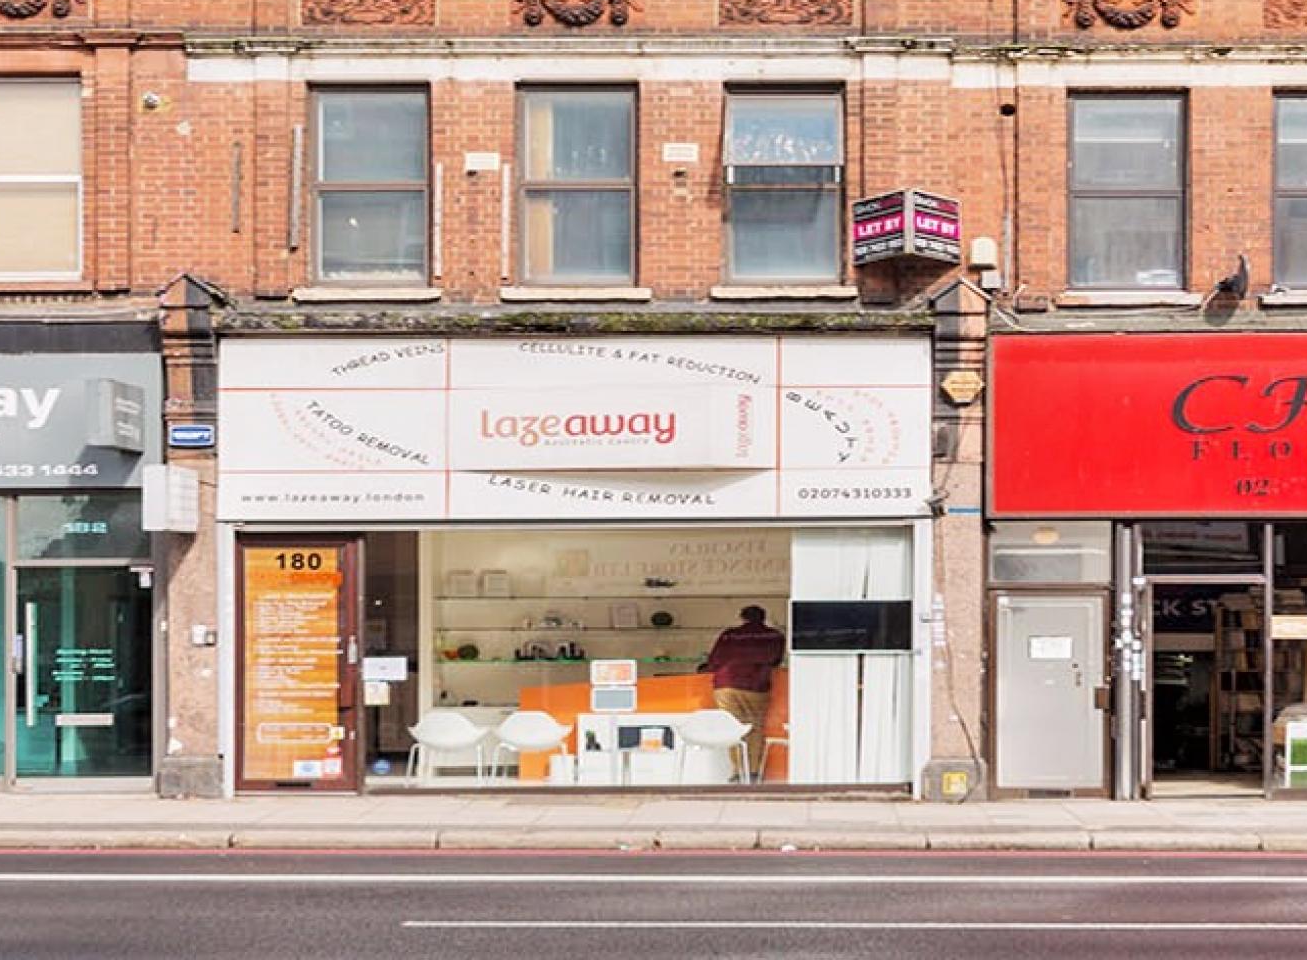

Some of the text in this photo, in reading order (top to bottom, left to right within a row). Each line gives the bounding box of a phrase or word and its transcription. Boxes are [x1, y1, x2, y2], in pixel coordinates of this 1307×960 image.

[858, 219, 882, 236] LET
[916, 216, 938, 231] LET
[331, 342, 445, 376] THREAD VEINS
[519, 341, 762, 384] CELLULITE & FAT REDUCTION
[306, 399, 354, 436] TATOO
[357, 432, 430, 465] REMOVAL
[480, 408, 676, 447] lazeaway
[40, 463, 99, 477] 1444
[488, 473, 716, 505] LASER HAIR REMOVAL
[798, 487, 912, 500] 02074310333
[275, 552, 322, 570] 180
